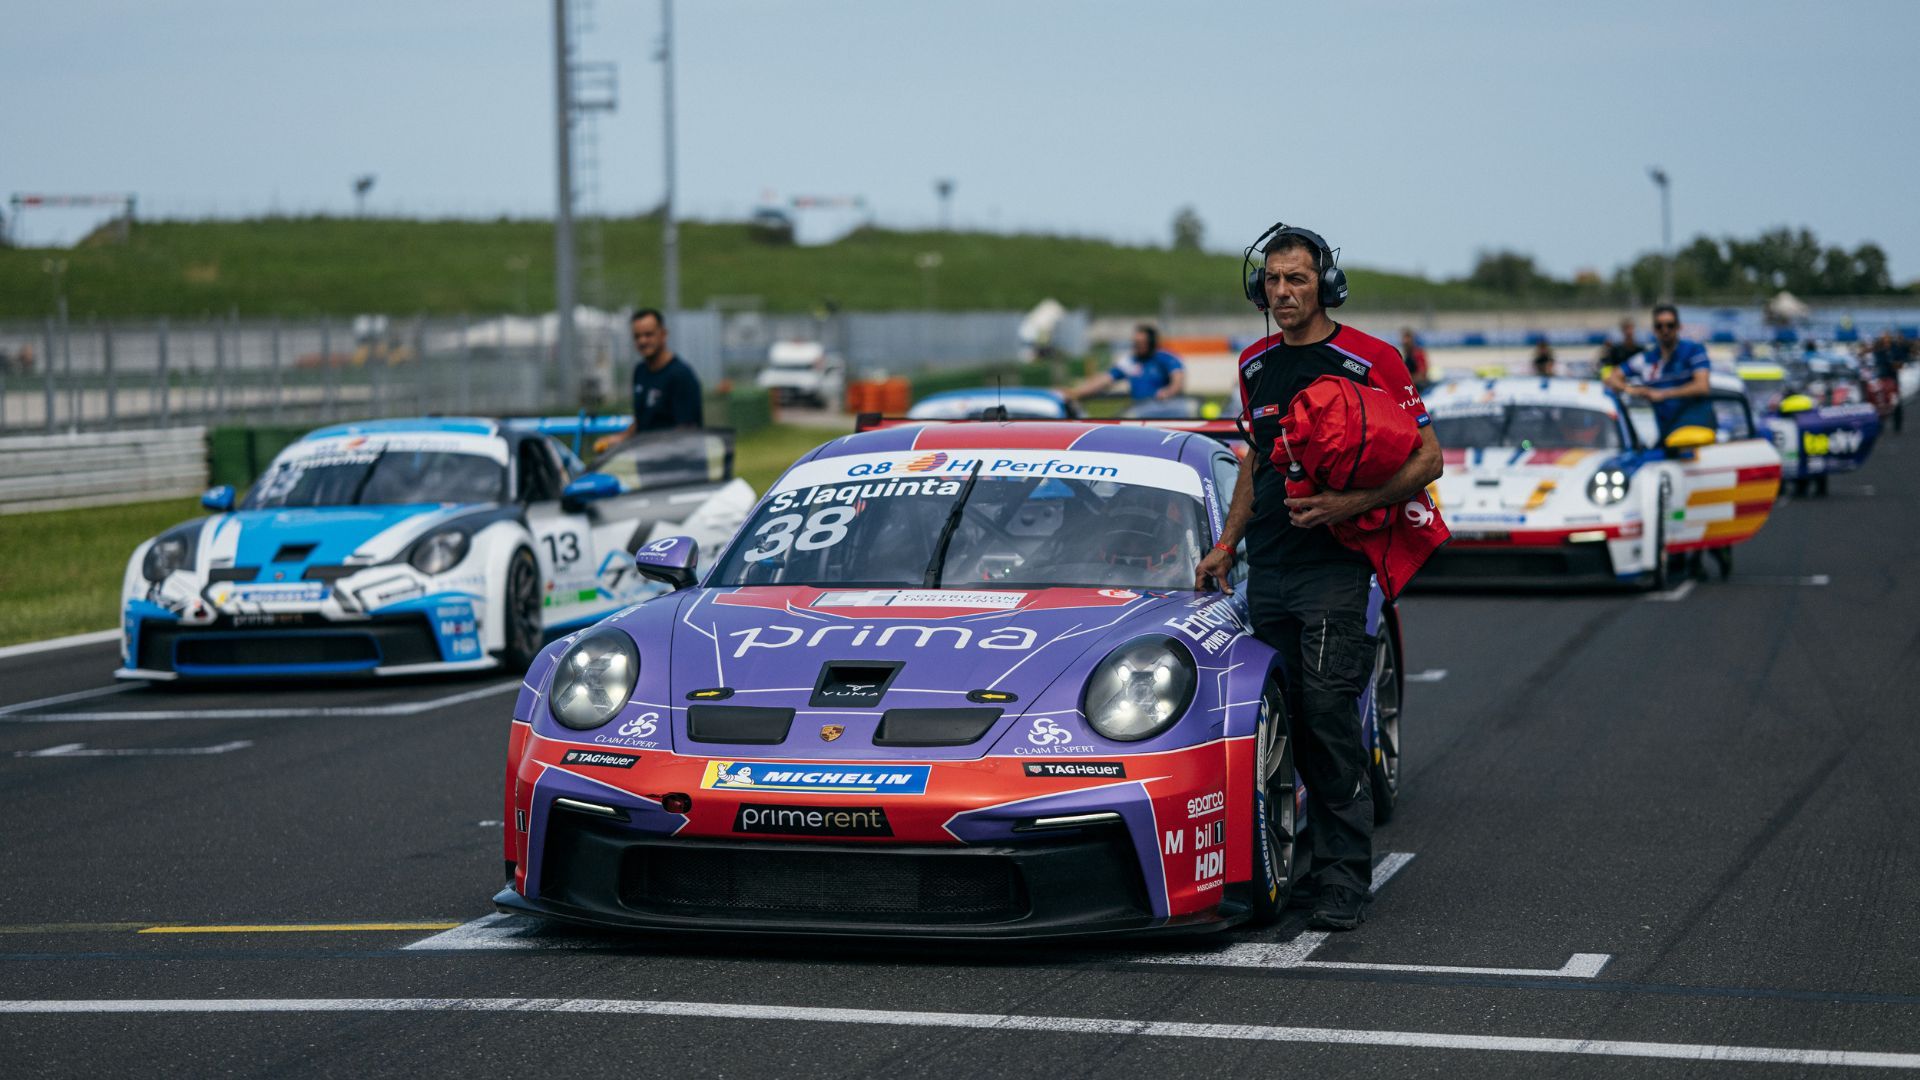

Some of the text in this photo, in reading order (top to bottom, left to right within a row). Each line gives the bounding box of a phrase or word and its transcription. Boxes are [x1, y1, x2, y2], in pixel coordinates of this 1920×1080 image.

[1399, 397, 1422, 410] YUM
[847, 461, 893, 477] Q8
[990, 459, 1118, 477] Perform
[542, 531, 580, 563] 13
[744, 505, 856, 563] 38
[904, 593, 1021, 601] COSTRUZIONI
[1163, 598, 1246, 641] Energy
[729, 625, 1038, 658] prima
[1201, 629, 1233, 655] POWER
[594, 734, 659, 749] CLAIM EXPERT
[1014, 745, 1096, 755] CLAIM EXPERT
[762, 771, 912, 785] MICHELIN
[1187, 790, 1224, 817] sparco
[742, 808, 882, 830] primerent
[1258, 799, 1272, 879] MICHELIN
[1195, 849, 1224, 881] HDI
